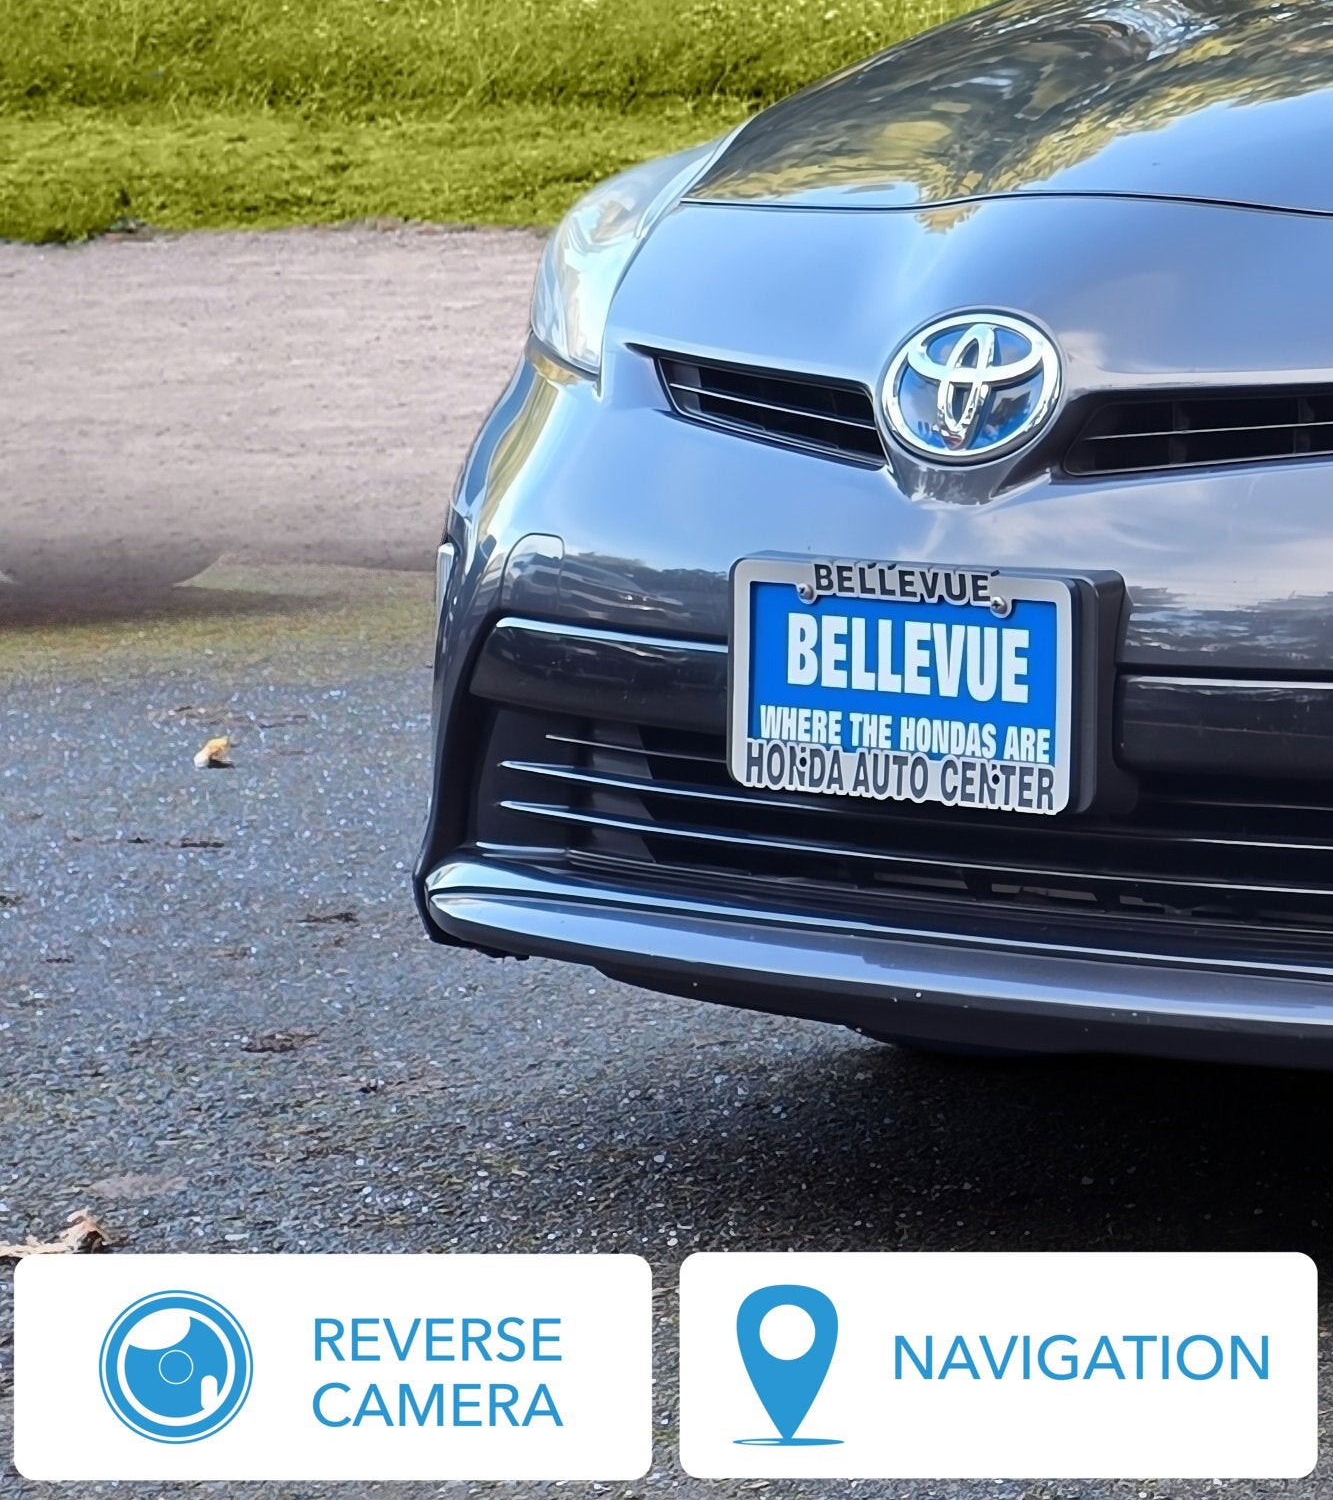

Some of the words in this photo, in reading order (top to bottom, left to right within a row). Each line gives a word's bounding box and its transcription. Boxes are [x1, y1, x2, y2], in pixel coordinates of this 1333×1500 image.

[814, 563, 990, 601] BELLEVUE
[787, 612, 1029, 704] BELLEVUE
[760, 704, 842, 744] WHERE
[849, 712, 892, 750] THE
[900, 717, 997, 760] HONDAS
[1004, 726, 1051, 764] ARE
[746, 741, 844, 791] HONDA
[853, 751, 929, 800] AUTO
[940, 759, 1055, 811] CENTER
